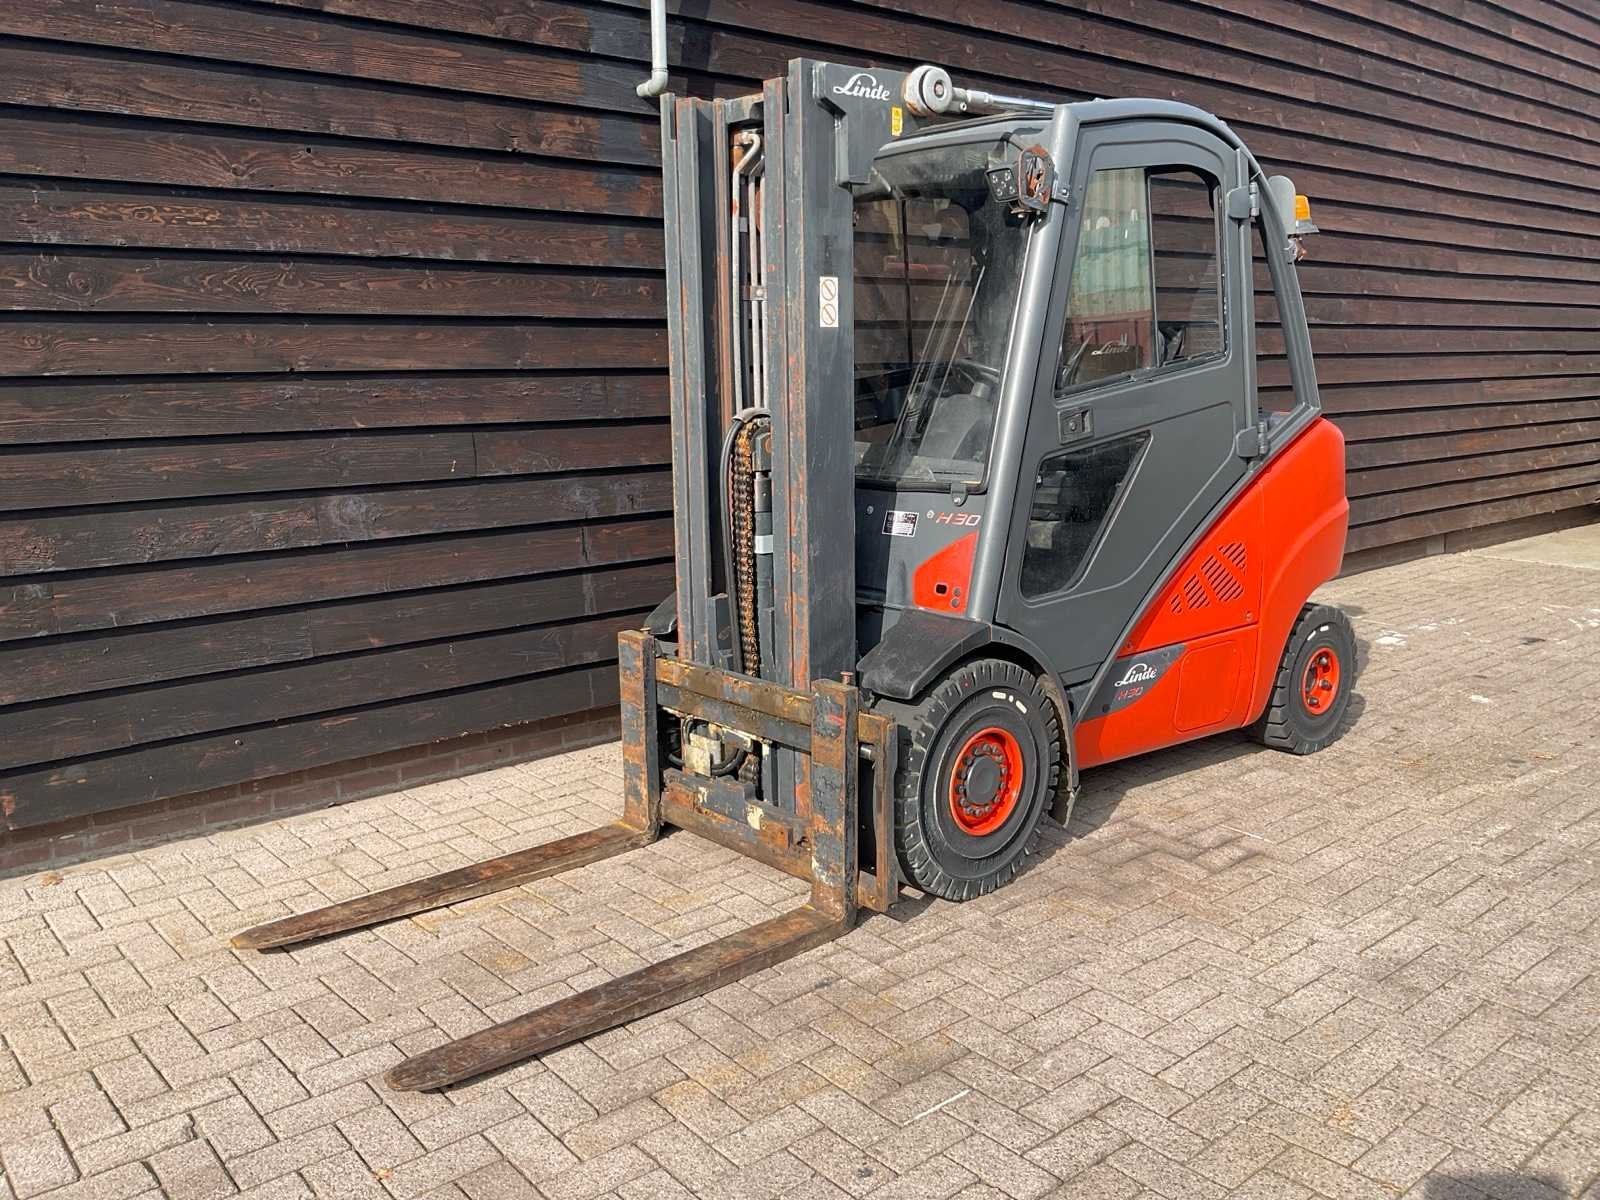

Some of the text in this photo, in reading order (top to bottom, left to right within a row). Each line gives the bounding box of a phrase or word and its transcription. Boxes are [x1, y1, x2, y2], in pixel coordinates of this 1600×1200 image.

[833, 73, 890, 101] Linde
[935, 512, 981, 526] H30
[1114, 663, 1157, 687] Linde
